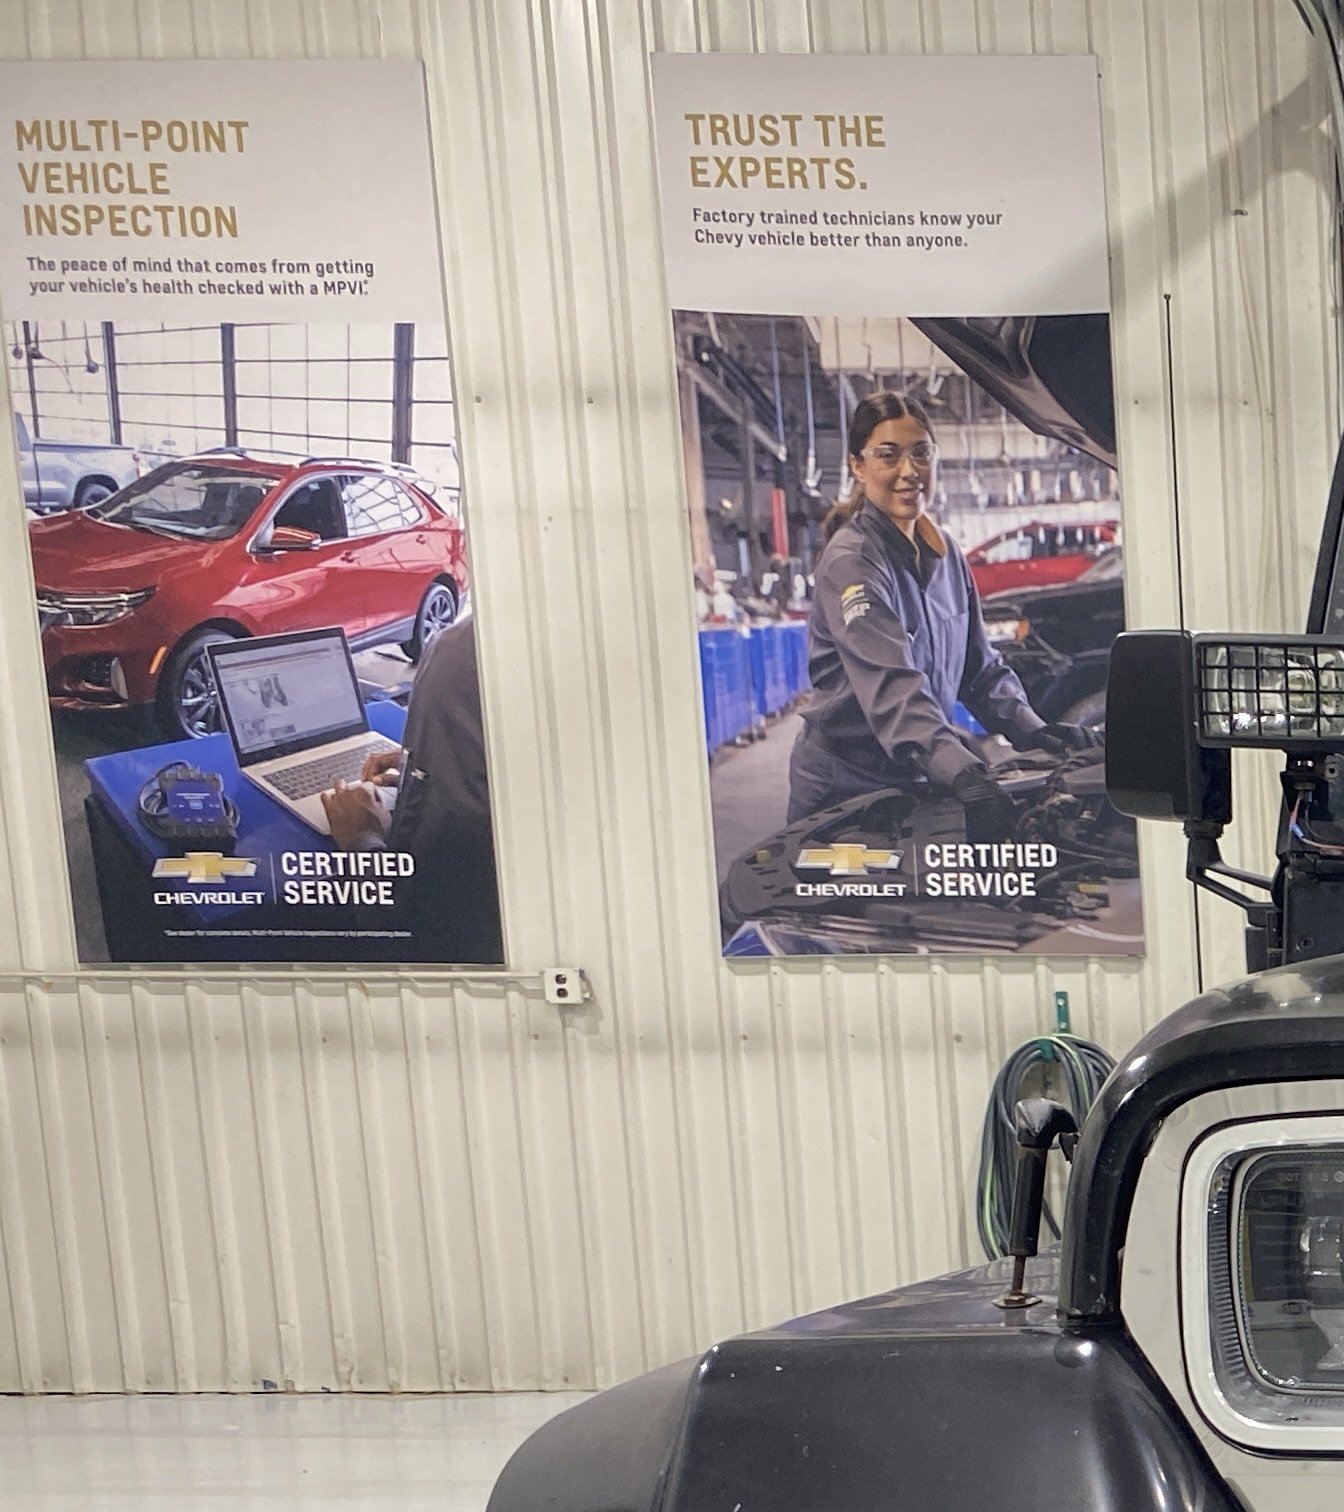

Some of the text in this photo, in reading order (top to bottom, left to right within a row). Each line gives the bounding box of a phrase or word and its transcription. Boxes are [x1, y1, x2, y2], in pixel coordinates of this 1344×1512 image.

[15, 119, 250, 153] MULTI-POINT
[684, 113, 886, 148] TRUST THE
[17, 161, 171, 195] VEHICLE
[689, 156, 868, 190] EXPERTS.
[23, 204, 239, 238] INSPECTION
[692, 207, 1003, 229] Factory trained technicians know your
[694, 229, 969, 250] Chevy vehicle better than anyone.
[27, 256, 375, 278] The peace of mind that comes from getting
[29, 280, 66, 296] your
[69, 277, 138, 295] vehicle's
[142, 278, 194, 295] health
[198, 279, 265, 296] checked
[269, 280, 305, 296] with
[310, 284, 320, 297] a
[280, 851, 415, 878] CERTIFIED
[923, 843, 1057, 869] CERTIFIED
[283, 880, 394, 906] SERVICE
[795, 883, 906, 897] CHEVROLET
[925, 872, 1037, 897] SERVICE
[153, 891, 266, 906] CHEVROLET
